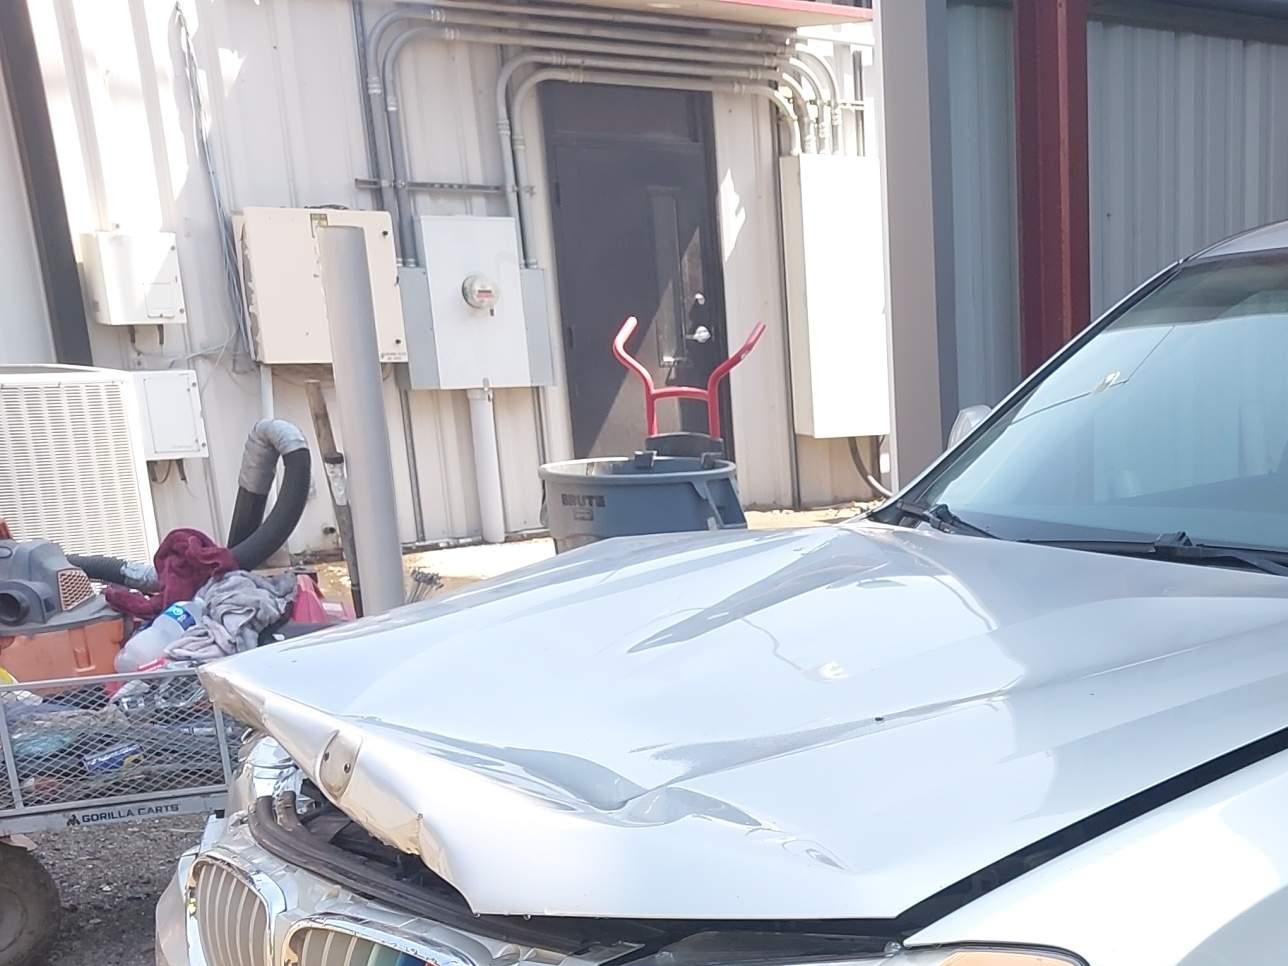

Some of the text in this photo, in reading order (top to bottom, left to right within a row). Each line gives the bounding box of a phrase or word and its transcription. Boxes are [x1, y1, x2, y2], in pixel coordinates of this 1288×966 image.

[560, 493, 606, 508] BRUTE
[82, 803, 180, 823] GORILLA CARTS
